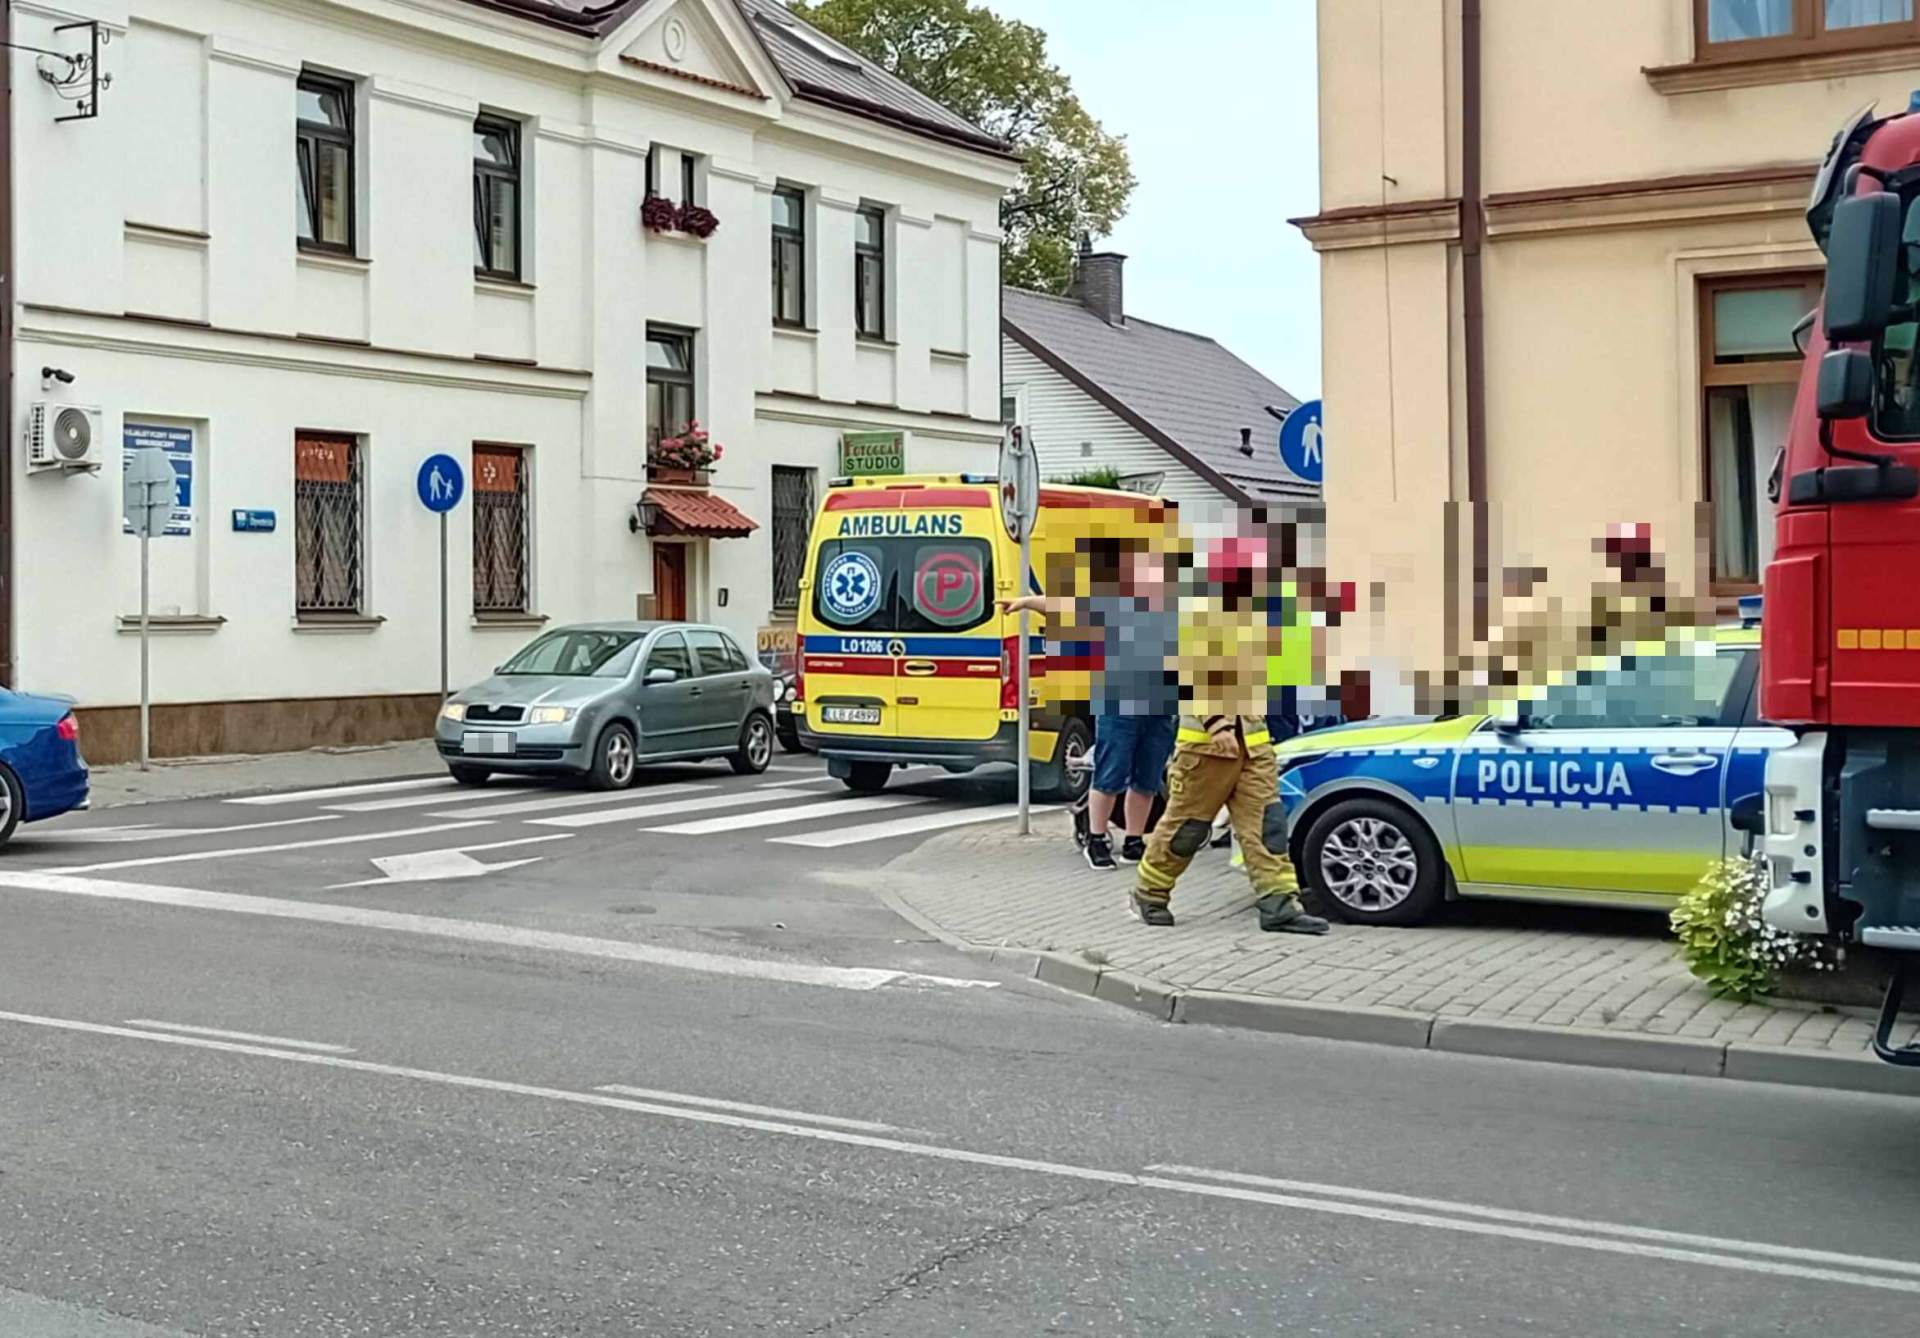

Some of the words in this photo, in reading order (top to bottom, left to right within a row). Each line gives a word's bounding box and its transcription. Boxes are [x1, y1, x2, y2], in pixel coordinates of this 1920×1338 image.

[846, 456, 900, 471] STUDIO
[838, 514, 962, 536] AMBULANS
[934, 566, 965, 603] P
[1478, 759, 1632, 796] POLICJA
